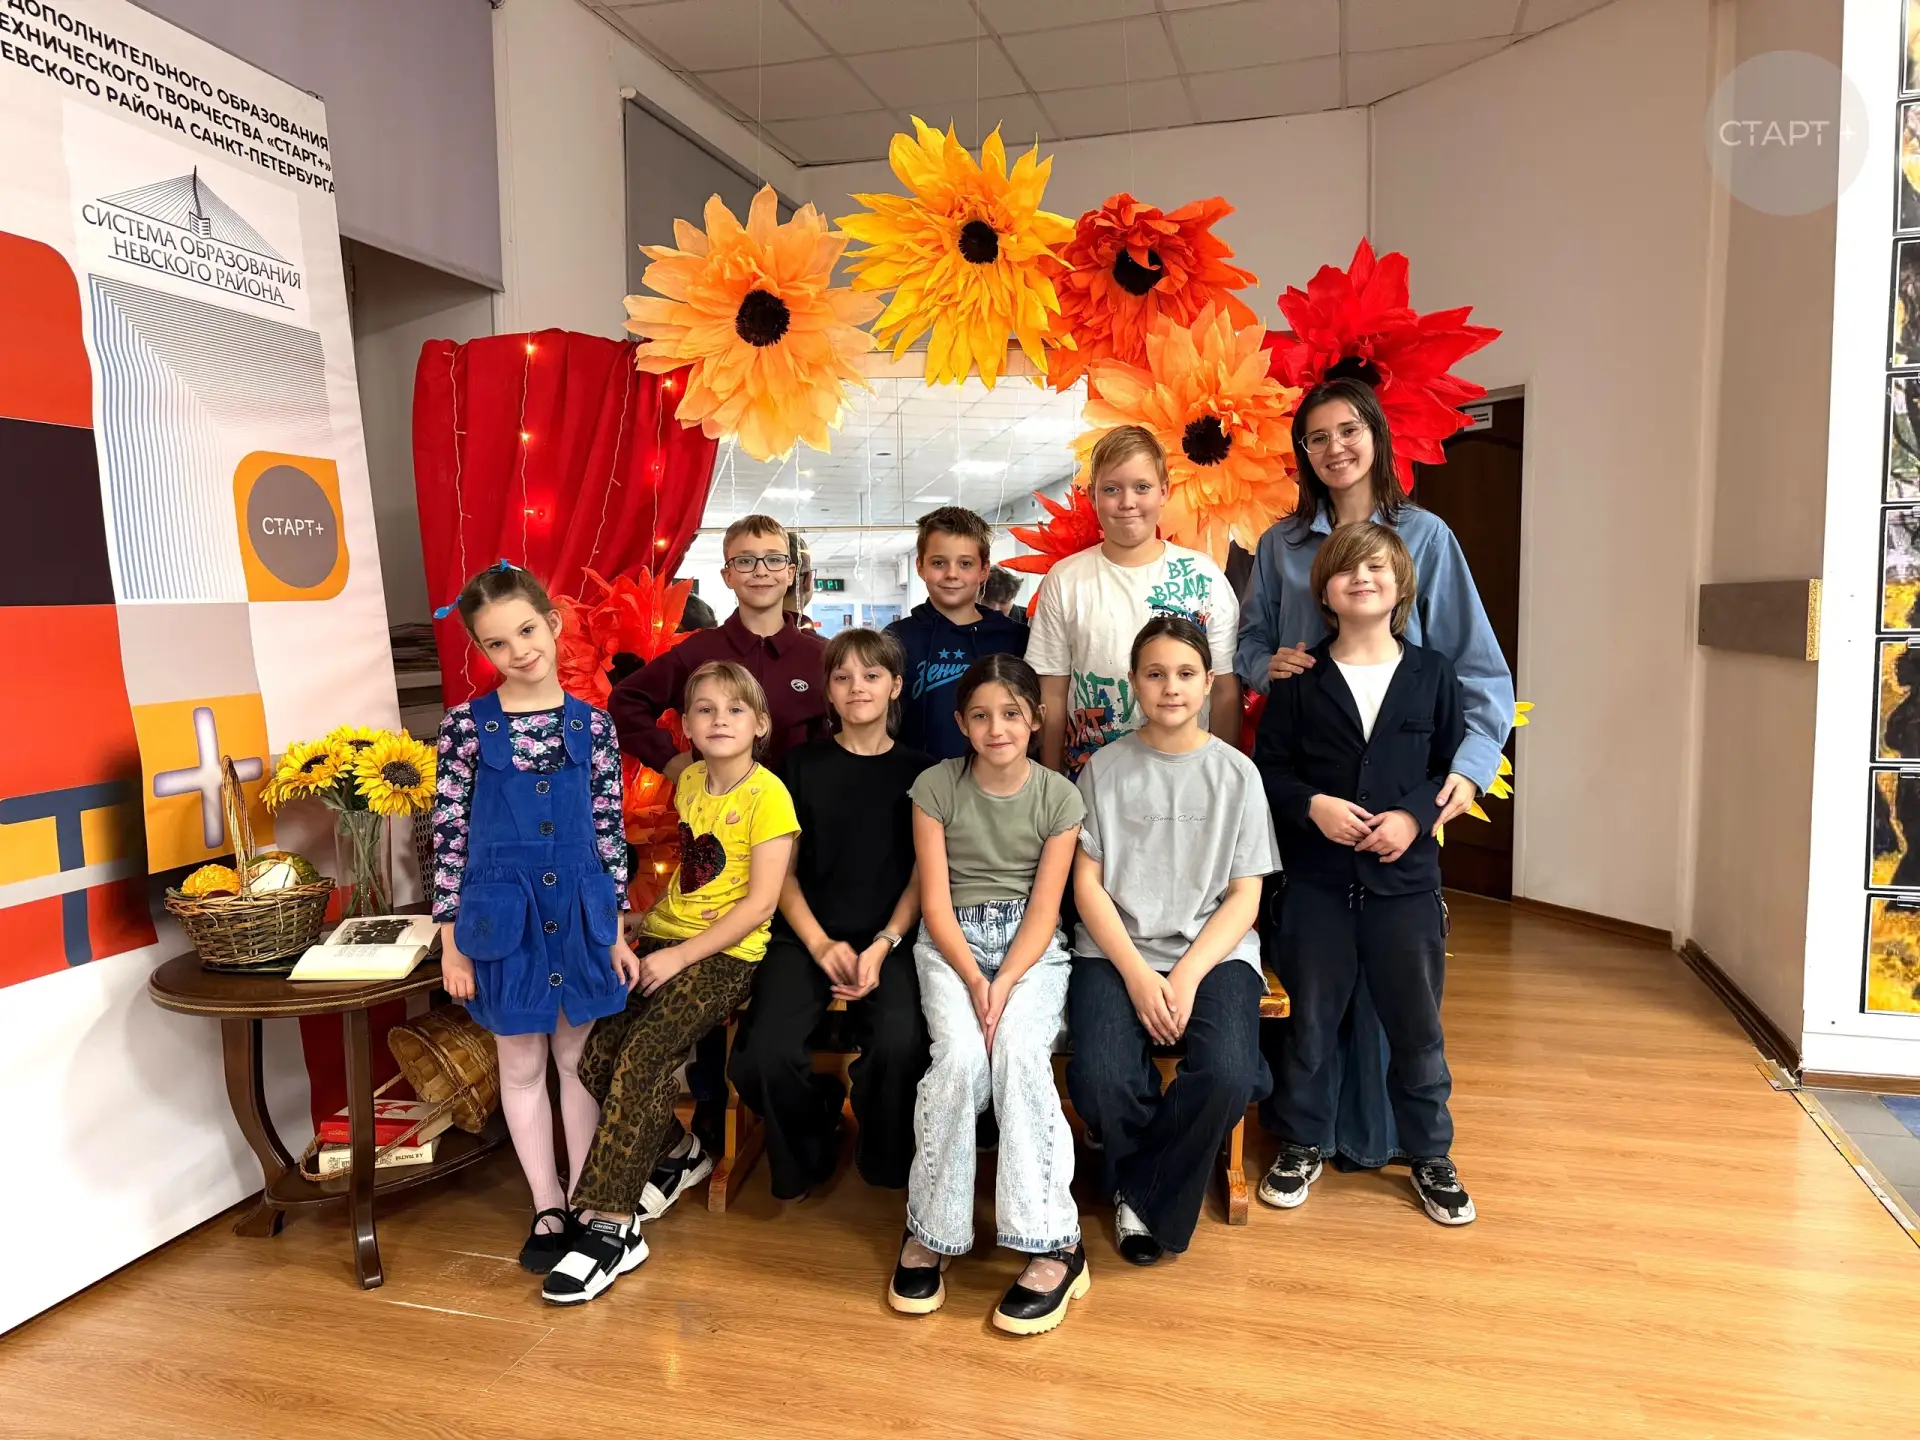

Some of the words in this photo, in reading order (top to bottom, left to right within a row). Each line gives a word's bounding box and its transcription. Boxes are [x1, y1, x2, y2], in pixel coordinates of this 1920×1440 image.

[8, 0, 213, 97] ДОПОЛНИТЕЛЬНОГО
[217, 88, 329, 151] ОБРАЗОВАНИЯ
[106, 85, 187, 134] РАЙОНА
[190, 122, 335, 194] САНКТ-ПЕТЕРБУРГА
[153, 81, 264, 144] ТВОРЧЕСТВА
[266, 136, 332, 172] «СТАРТ+»
[82, 204, 177, 250] СИСТЕМА
[180, 236, 301, 289] ОБРАЗОВАНИЯ
[113, 236, 212, 281] НЕВСКОГО
[216, 267, 285, 304] РАЙОНА
[261, 516, 325, 537] СТАРТ+
[1151, 573, 1213, 602] BRAVE
[1167, 557, 1197, 580] BE
